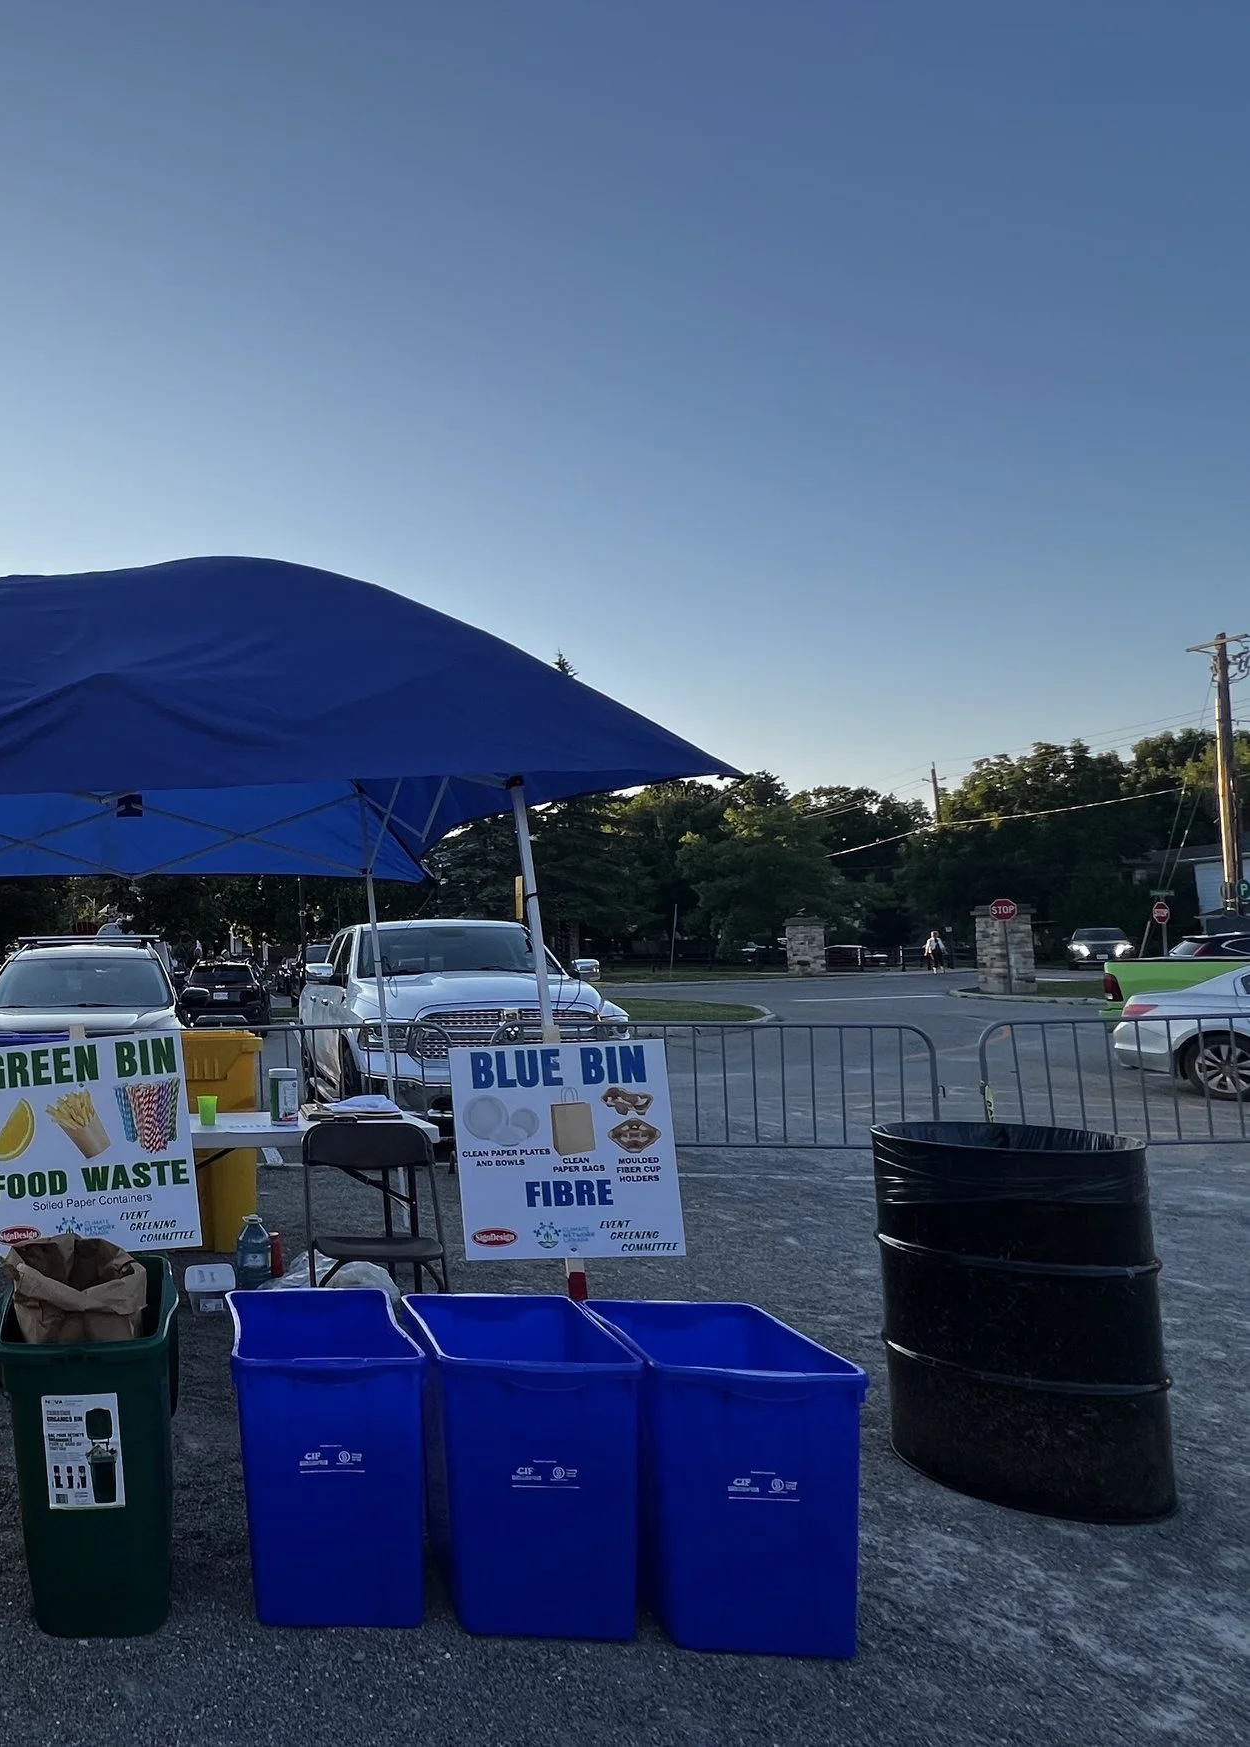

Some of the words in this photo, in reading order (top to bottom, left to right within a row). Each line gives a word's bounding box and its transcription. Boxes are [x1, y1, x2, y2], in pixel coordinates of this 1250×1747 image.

[1240, 884, 1248, 896] P
[991, 905, 1015, 915] STOP
[114, 1036, 177, 1079] BIN
[470, 1048, 564, 1089] BLUE
[579, 1045, 647, 1086] BIN
[462, 1150, 489, 1158] CLEAN
[490, 1149, 517, 1157] PAPER
[519, 1148, 551, 1156] PLATES
[476, 1159, 493, 1167] AND
[616, 1166, 641, 1174] FIBER
[643, 1165, 662, 1173] CUP
[81, 1159, 190, 1193] WASTE
[619, 1175, 660, 1183] HOLDERS
[525, 1179, 614, 1207] FIBRE
[32, 1200, 64, 1212] Soiled
[66, 1198, 96, 1211] Paper
[98, 1193, 152, 1206] Containers
[119, 1210, 150, 1221] EVENT
[129, 1219, 177, 1232] GREENING
[599, 1219, 632, 1229] EVENT
[139, 1230, 195, 1243] COMMITTEE
[610, 1230, 659, 1240] GREENING
[621, 1242, 679, 1252] COMMITTEE
